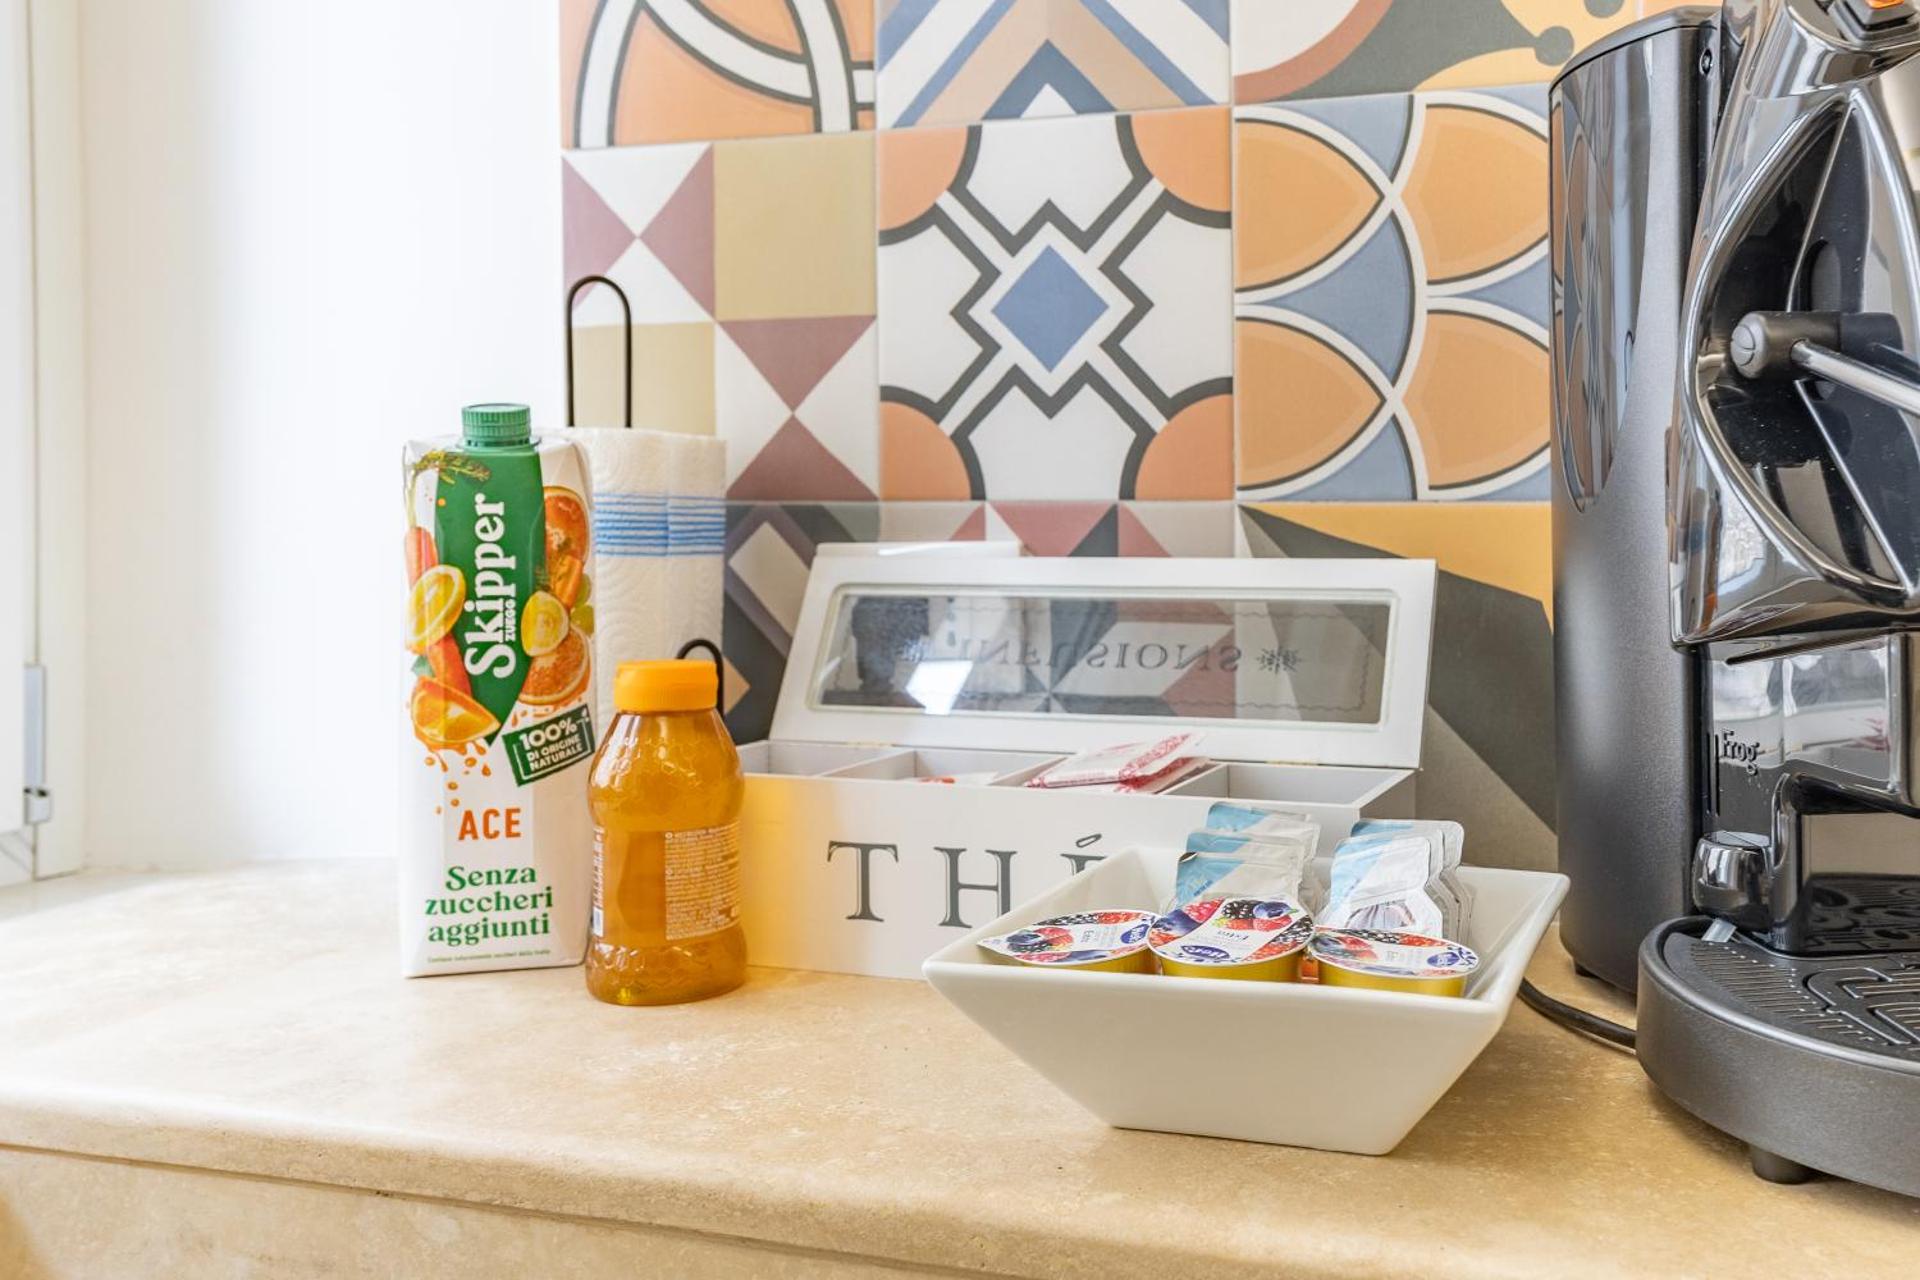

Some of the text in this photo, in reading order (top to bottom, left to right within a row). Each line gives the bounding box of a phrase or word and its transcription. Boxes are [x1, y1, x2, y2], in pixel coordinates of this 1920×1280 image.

[464, 493, 517, 679] Skipper
[519, 717, 577, 750] 100%
[526, 733, 581, 761] DI ORIGINE
[530, 743, 583, 771] NATURALE
[458, 808, 522, 841] ACE
[446, 866, 537, 891] Senza
[425, 886, 553, 915] zuccheri
[428, 913, 550, 947] aggiunti
